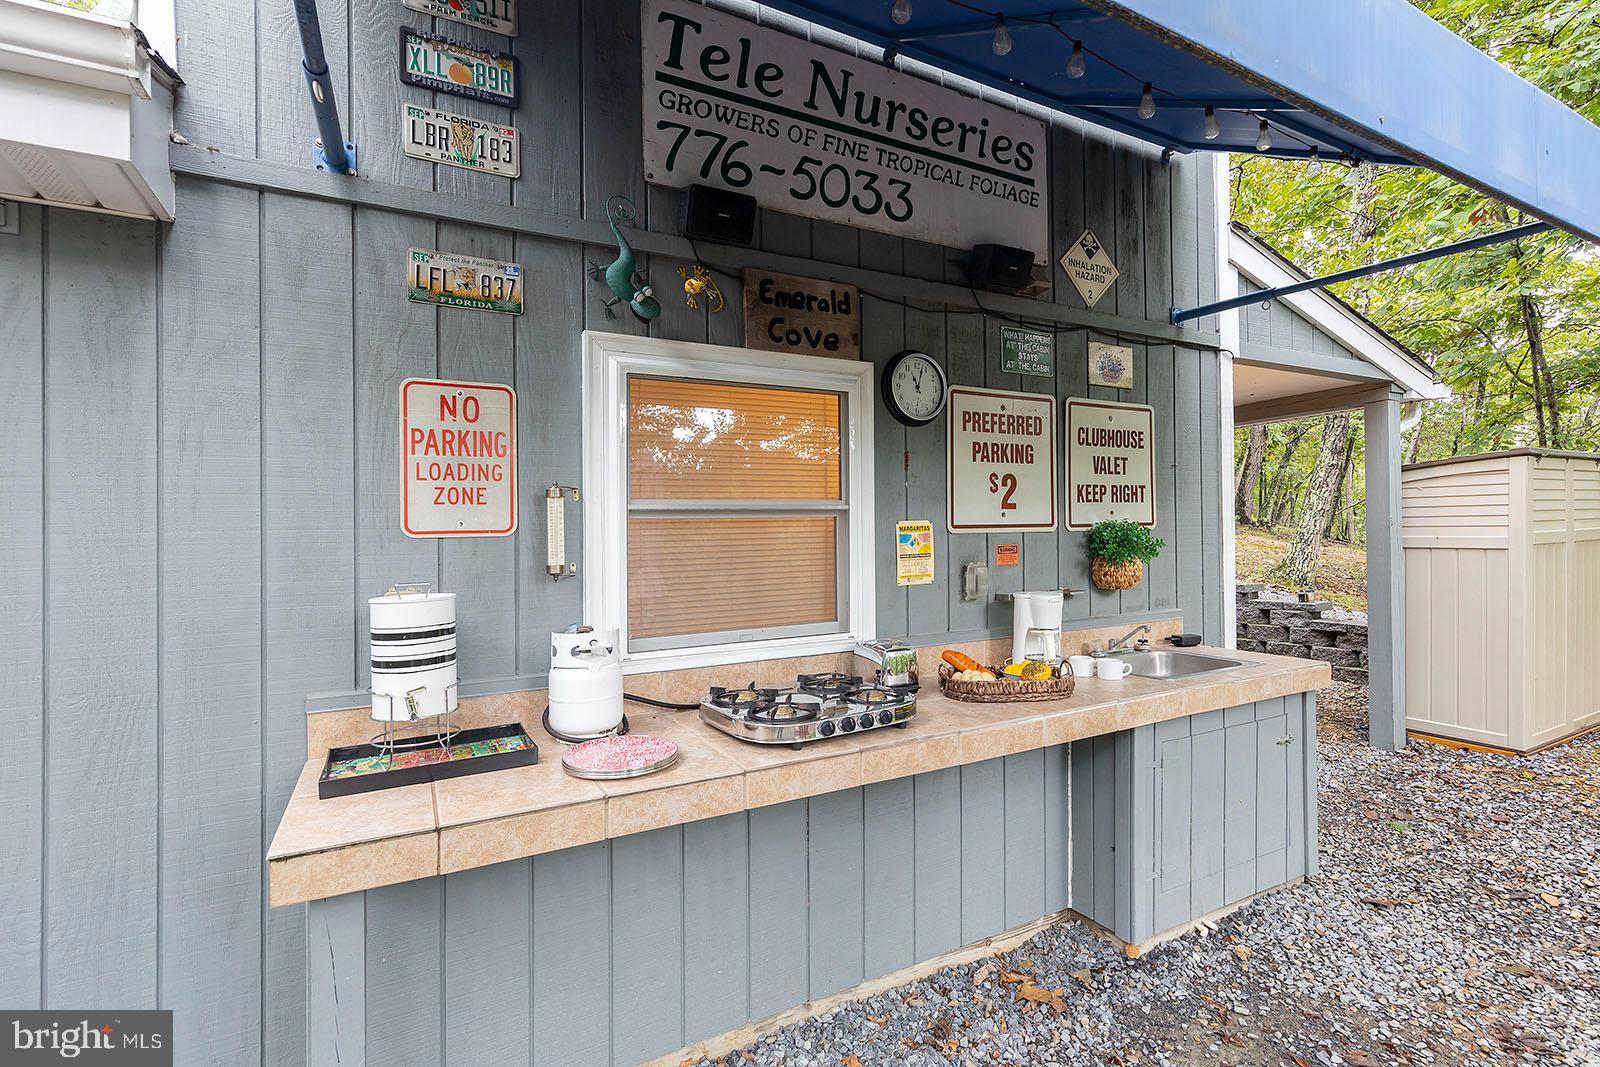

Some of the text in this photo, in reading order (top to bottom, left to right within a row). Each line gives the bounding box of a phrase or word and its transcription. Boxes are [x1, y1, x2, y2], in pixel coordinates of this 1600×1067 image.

[431, 4, 492, 28] PALM BEACH
[406, 34, 422, 44] SEP
[408, 45, 512, 94] XLL 89R
[657, 11, 1034, 172] Tele Nurseries
[408, 107, 425, 120] SEP
[435, 112, 490, 131] FLORIDA
[410, 119, 513, 163] LBR 183
[658, 89, 1040, 208] GROWERS OF FINE TROPICAL FOLIAGE
[440, 153, 485, 168] PANTHER
[413, 252, 430, 263] SEP
[1068, 257, 1112, 275] INHALATION
[415, 264, 516, 301] LFL 837
[1075, 269, 1105, 284] HAZARD
[440, 296, 494, 310] FLORIDA
[758, 278, 851, 315] Emerald
[1087, 289, 1093, 300] 2
[767, 316, 840, 352] Cove
[1003, 330, 1022, 341] WHAT
[1017, 342, 1031, 351] THE
[913, 361, 920, 370] 12
[1006, 360, 1016, 369] AT
[1017, 361, 1030, 371] THE
[1017, 351, 1039, 362] STAYS
[898, 372, 906, 380] 10
[439, 394, 480, 424] NO
[962, 410, 1043, 436] PREFERRED
[410, 427, 507, 458] PARKING
[1077, 427, 1144, 449] CLUBHOUSE
[972, 441, 1034, 464] PARKING
[415, 462, 503, 482] LOADING
[1093, 455, 1128, 475] VALET
[433, 486, 487, 506] ZONE
[1076, 484, 1146, 503] KEEP RIGHT
